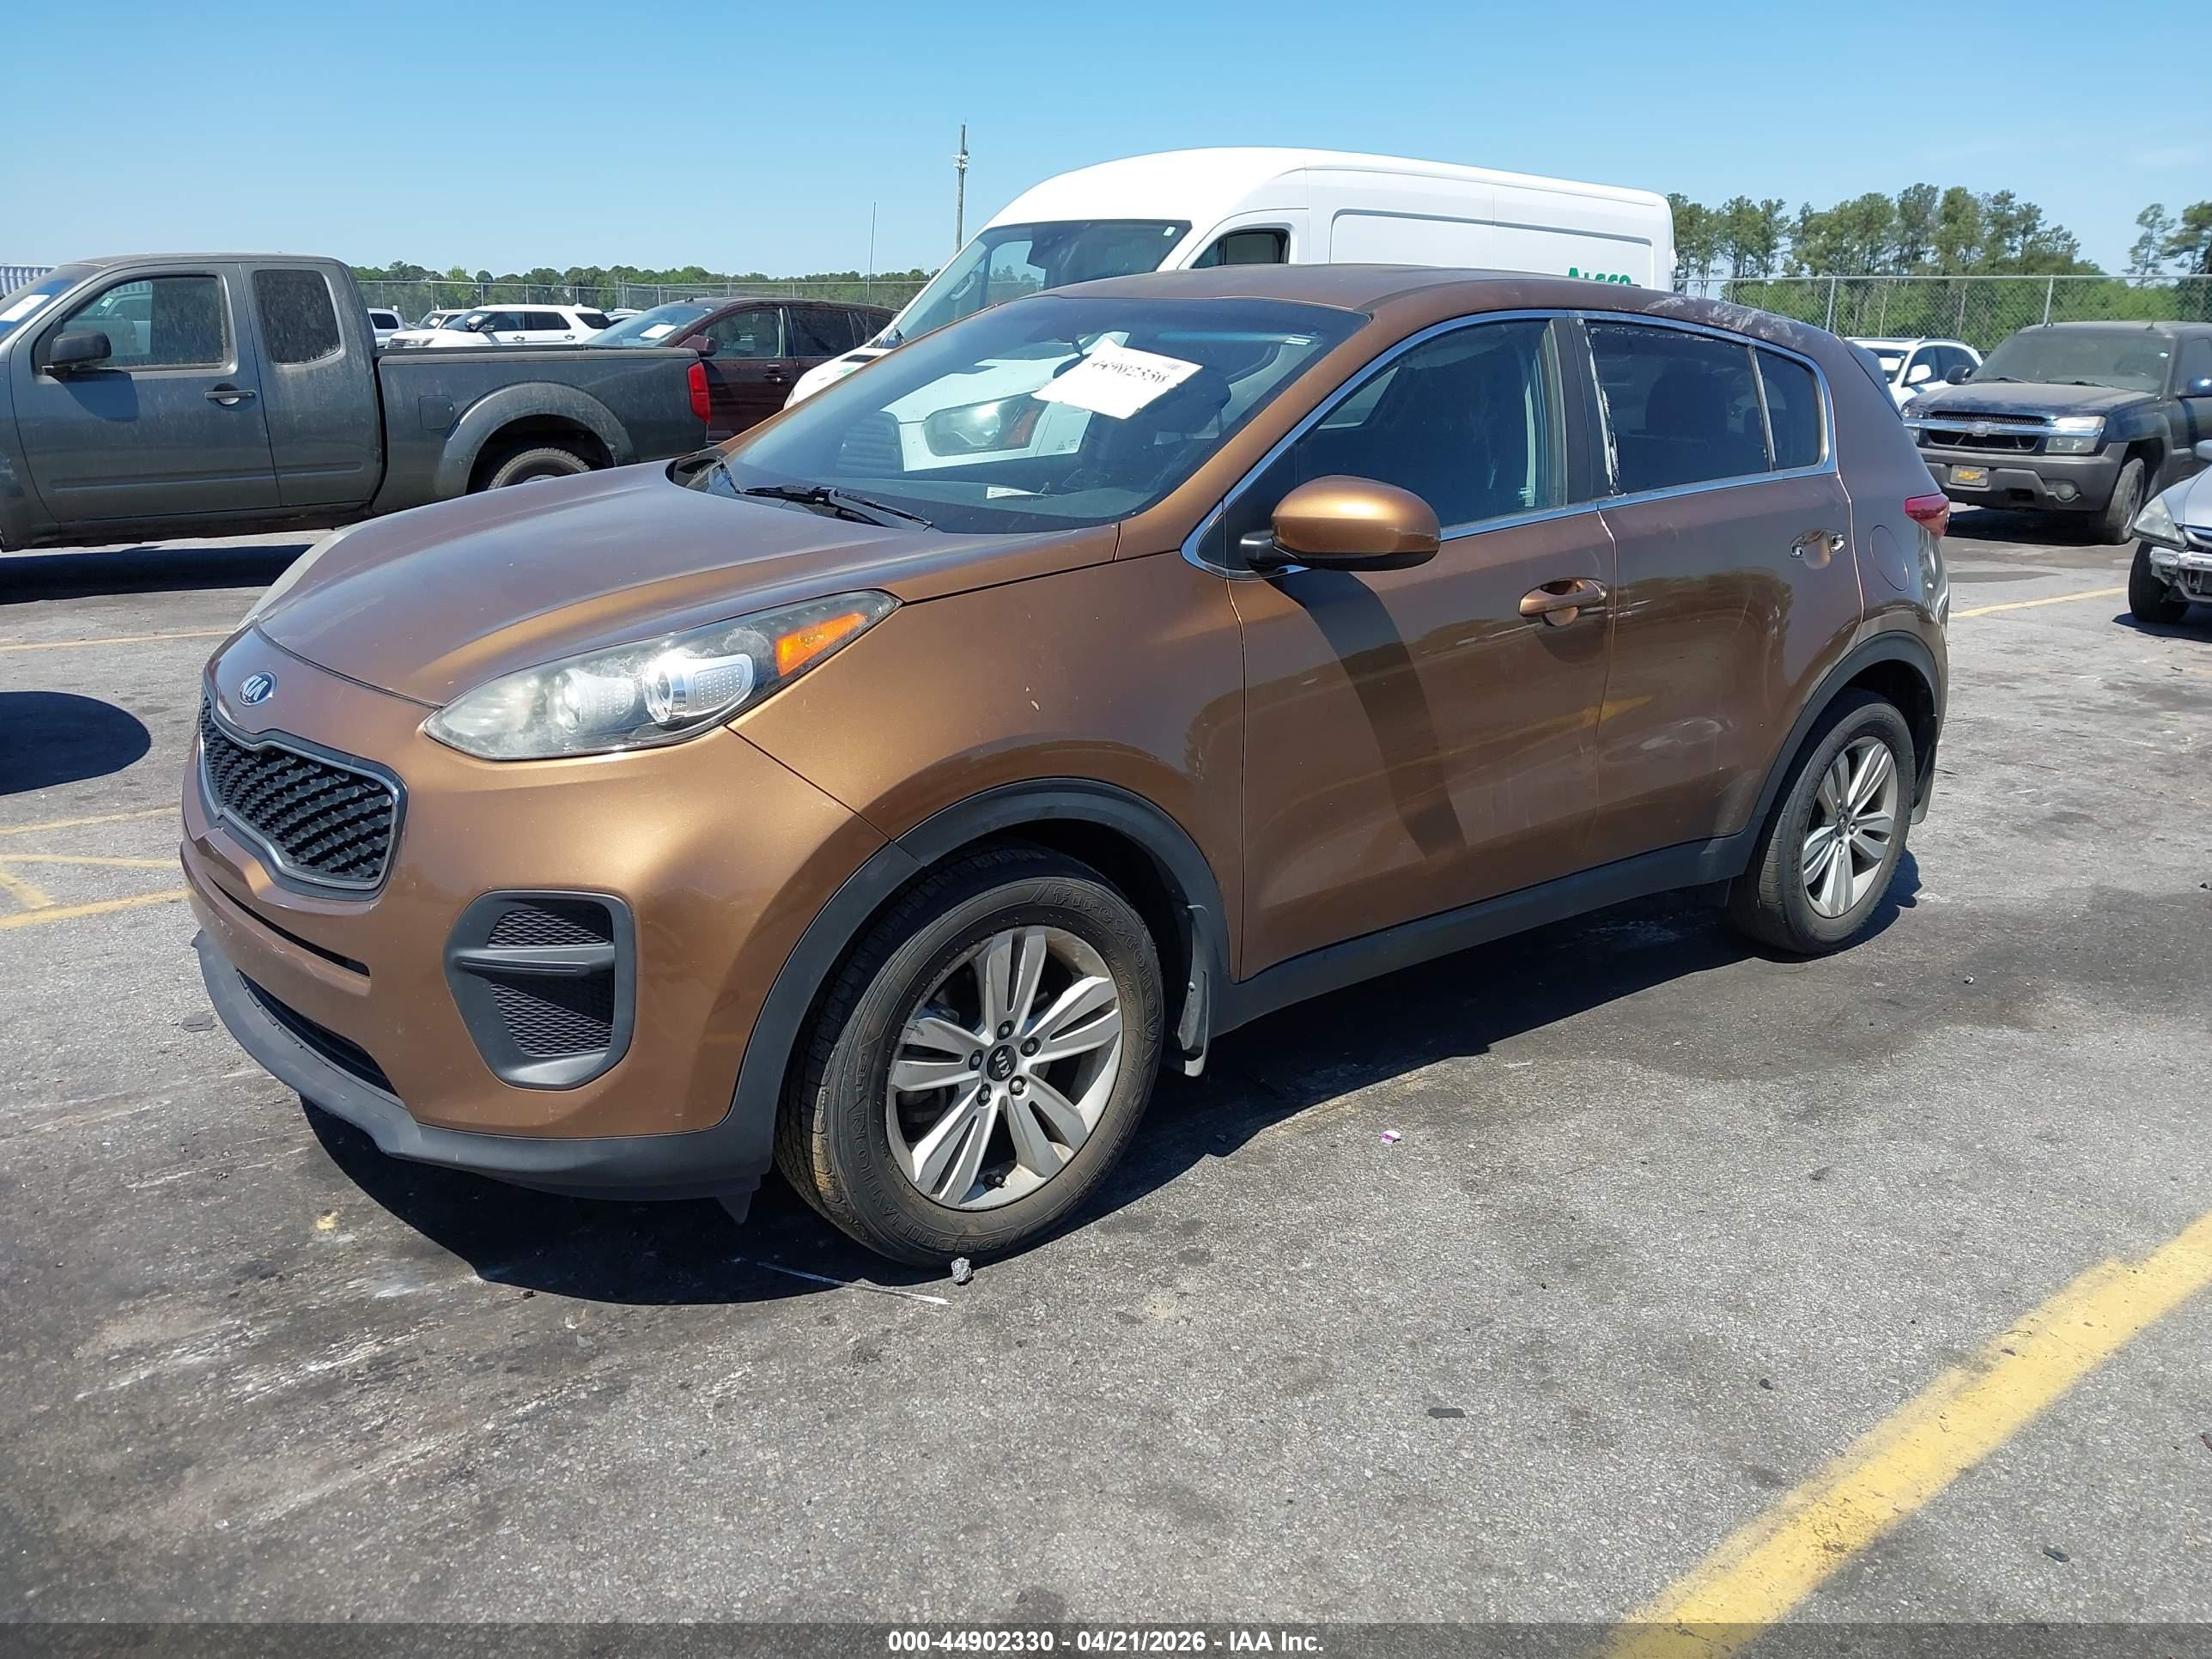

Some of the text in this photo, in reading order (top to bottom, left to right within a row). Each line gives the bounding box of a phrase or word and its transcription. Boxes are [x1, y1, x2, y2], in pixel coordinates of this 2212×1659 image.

[243, 674, 269, 701] KIA
[1053, 885, 1157, 1012] Firestone
[995, 1050, 1012, 1079] KIA
